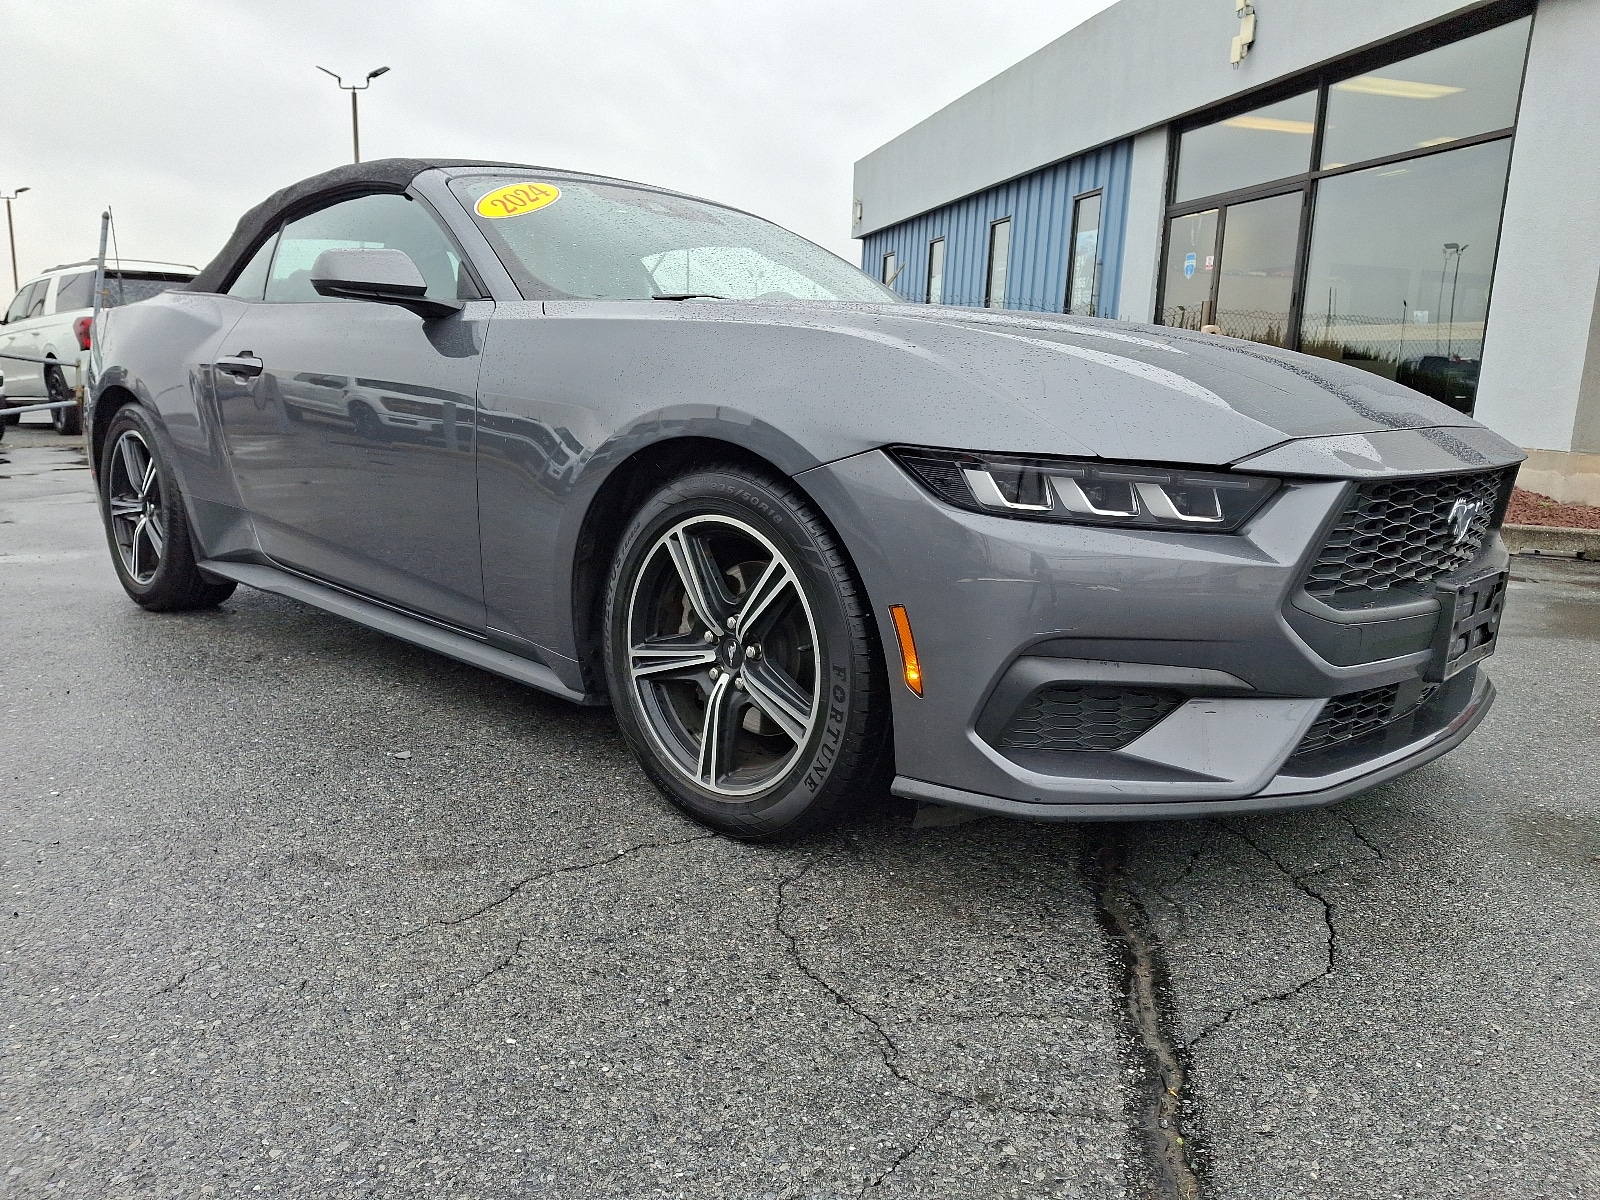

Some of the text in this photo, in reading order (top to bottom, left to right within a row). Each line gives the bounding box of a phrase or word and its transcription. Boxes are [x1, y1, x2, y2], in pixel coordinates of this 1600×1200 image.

[490, 185, 551, 213] 2024
[710, 482, 783, 524] 235/50R18
[803, 663, 847, 795] FORTUNE
